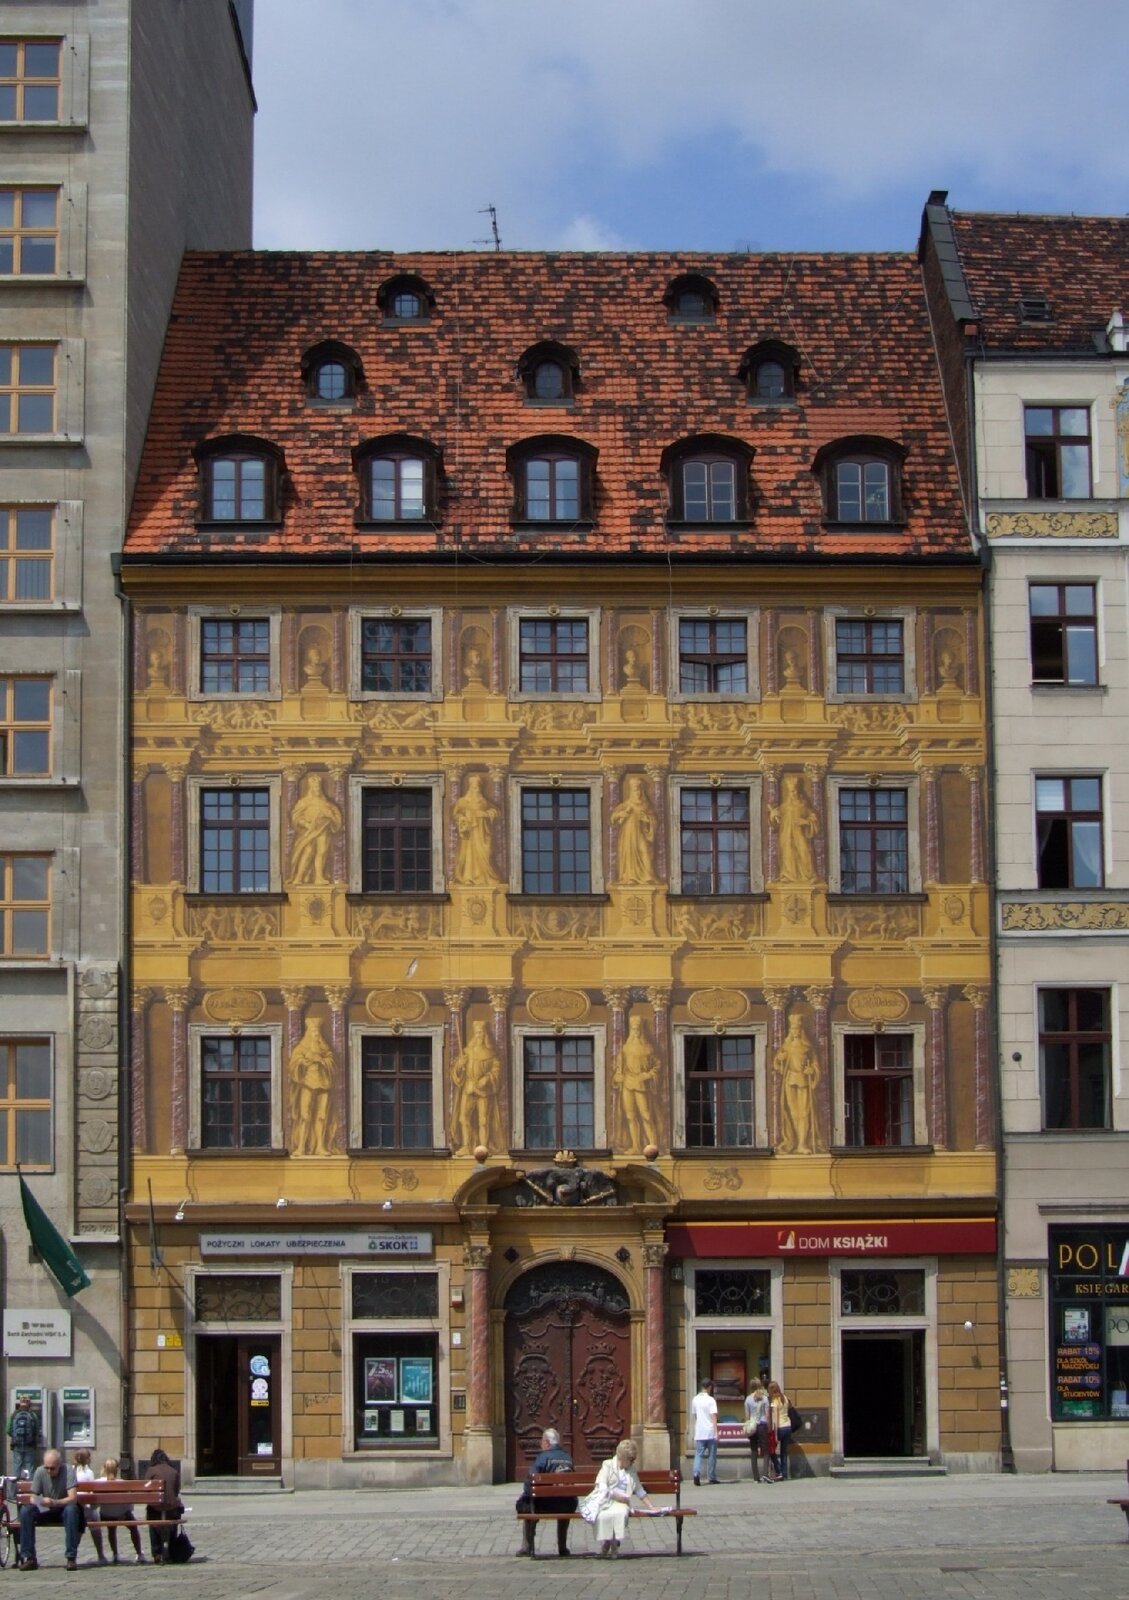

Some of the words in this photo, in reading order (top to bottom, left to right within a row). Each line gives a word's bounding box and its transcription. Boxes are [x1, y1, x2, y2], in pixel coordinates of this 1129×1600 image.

[206, 1238, 245, 1248] POŻYCZKI
[250, 1240, 280, 1248] LOKATY
[286, 1239, 346, 1248] UBEZPIECZENIA
[378, 1240, 408, 1250] SKOK
[798, 1237, 830, 1249] DOM
[833, 1233, 888, 1250] KSIĄŻKI
[1057, 1347, 1082, 1355] RABAT
[1057, 1376, 1082, 1384] RABAT
[1085, 1376, 1101, 1384] 10%
